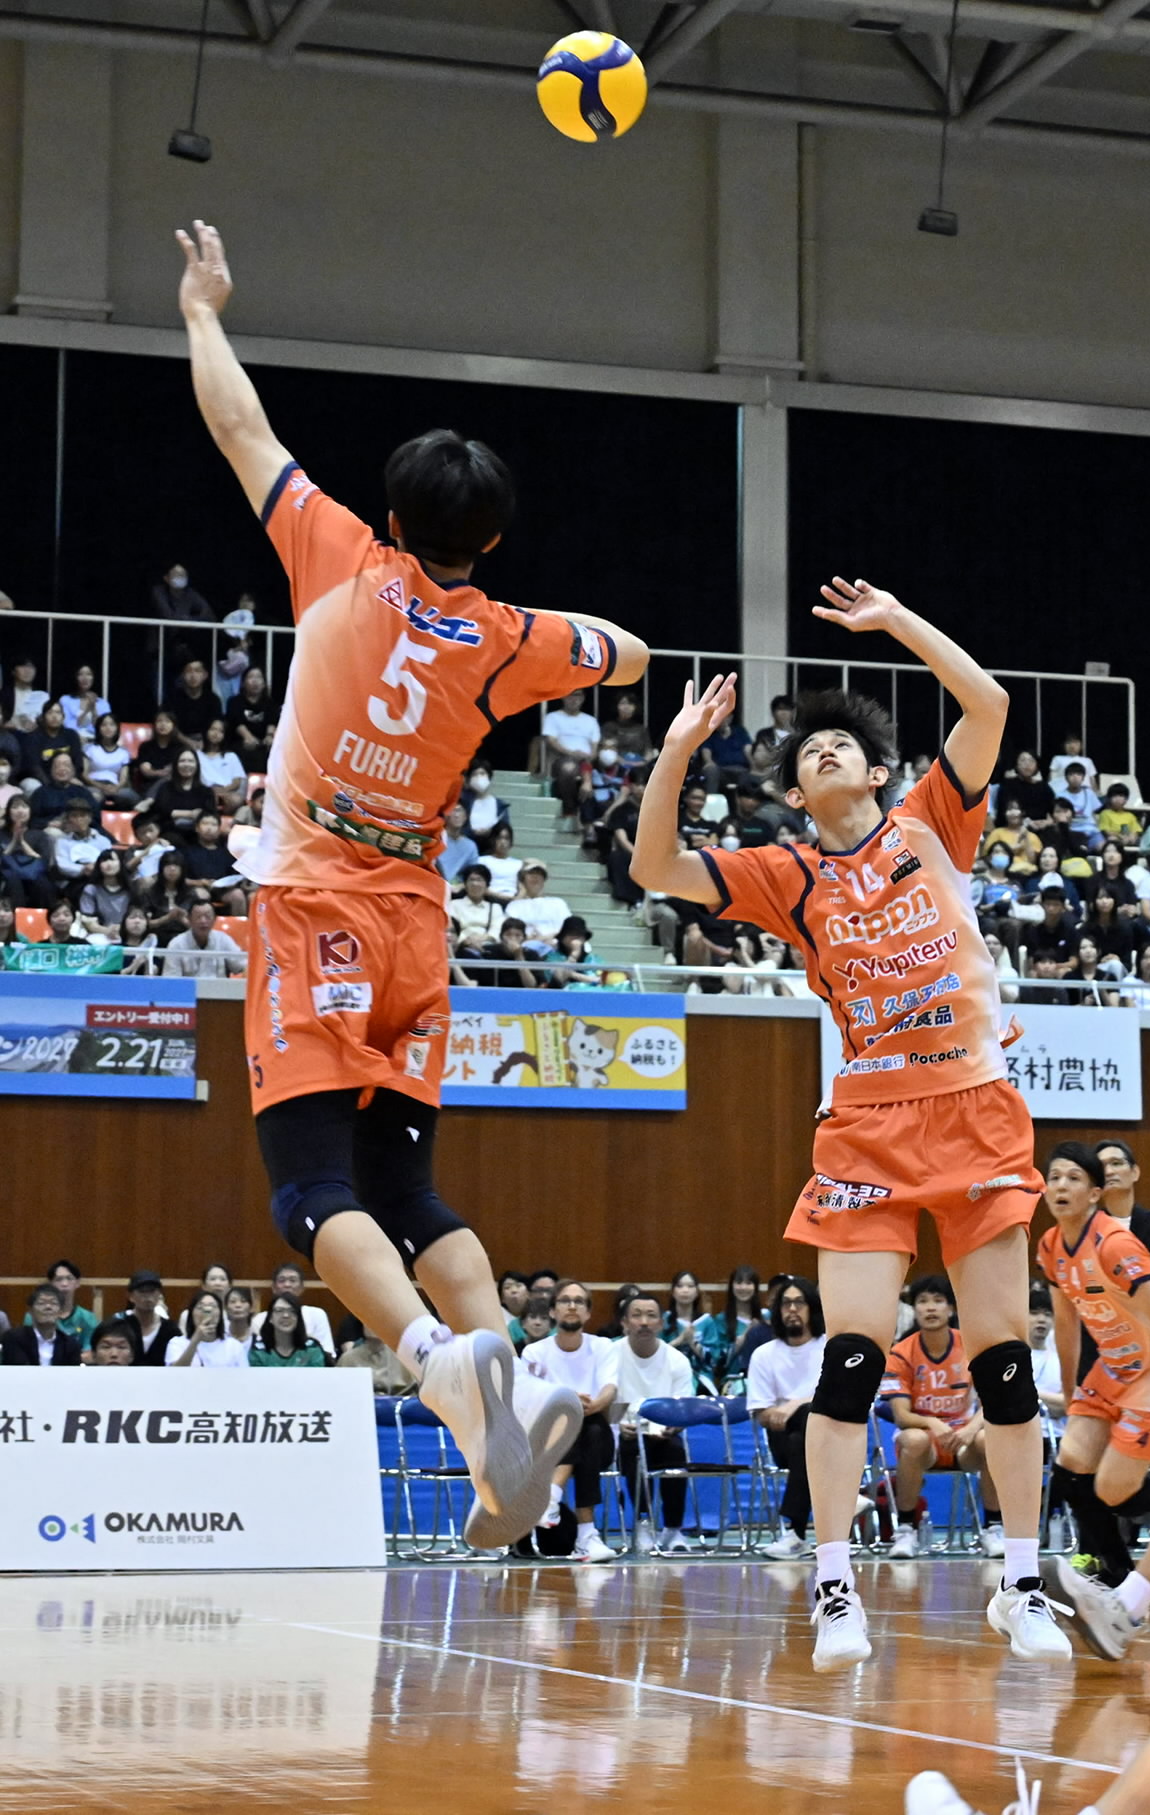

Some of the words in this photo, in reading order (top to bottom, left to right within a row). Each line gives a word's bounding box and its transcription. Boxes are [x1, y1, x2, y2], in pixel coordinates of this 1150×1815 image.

[367, 631, 438, 736] 5
[333, 729, 418, 787] FURUI
[846, 863, 885, 902] 14
[826, 884, 938, 946] nippn
[861, 930, 959, 980] Yupiteru
[96, 1036, 163, 1068] 2.21
[631, 1038, 678, 1050] ふるさと
[929, 1370, 948, 1389] 12
[104, 1512, 245, 1533] OKAMURA
